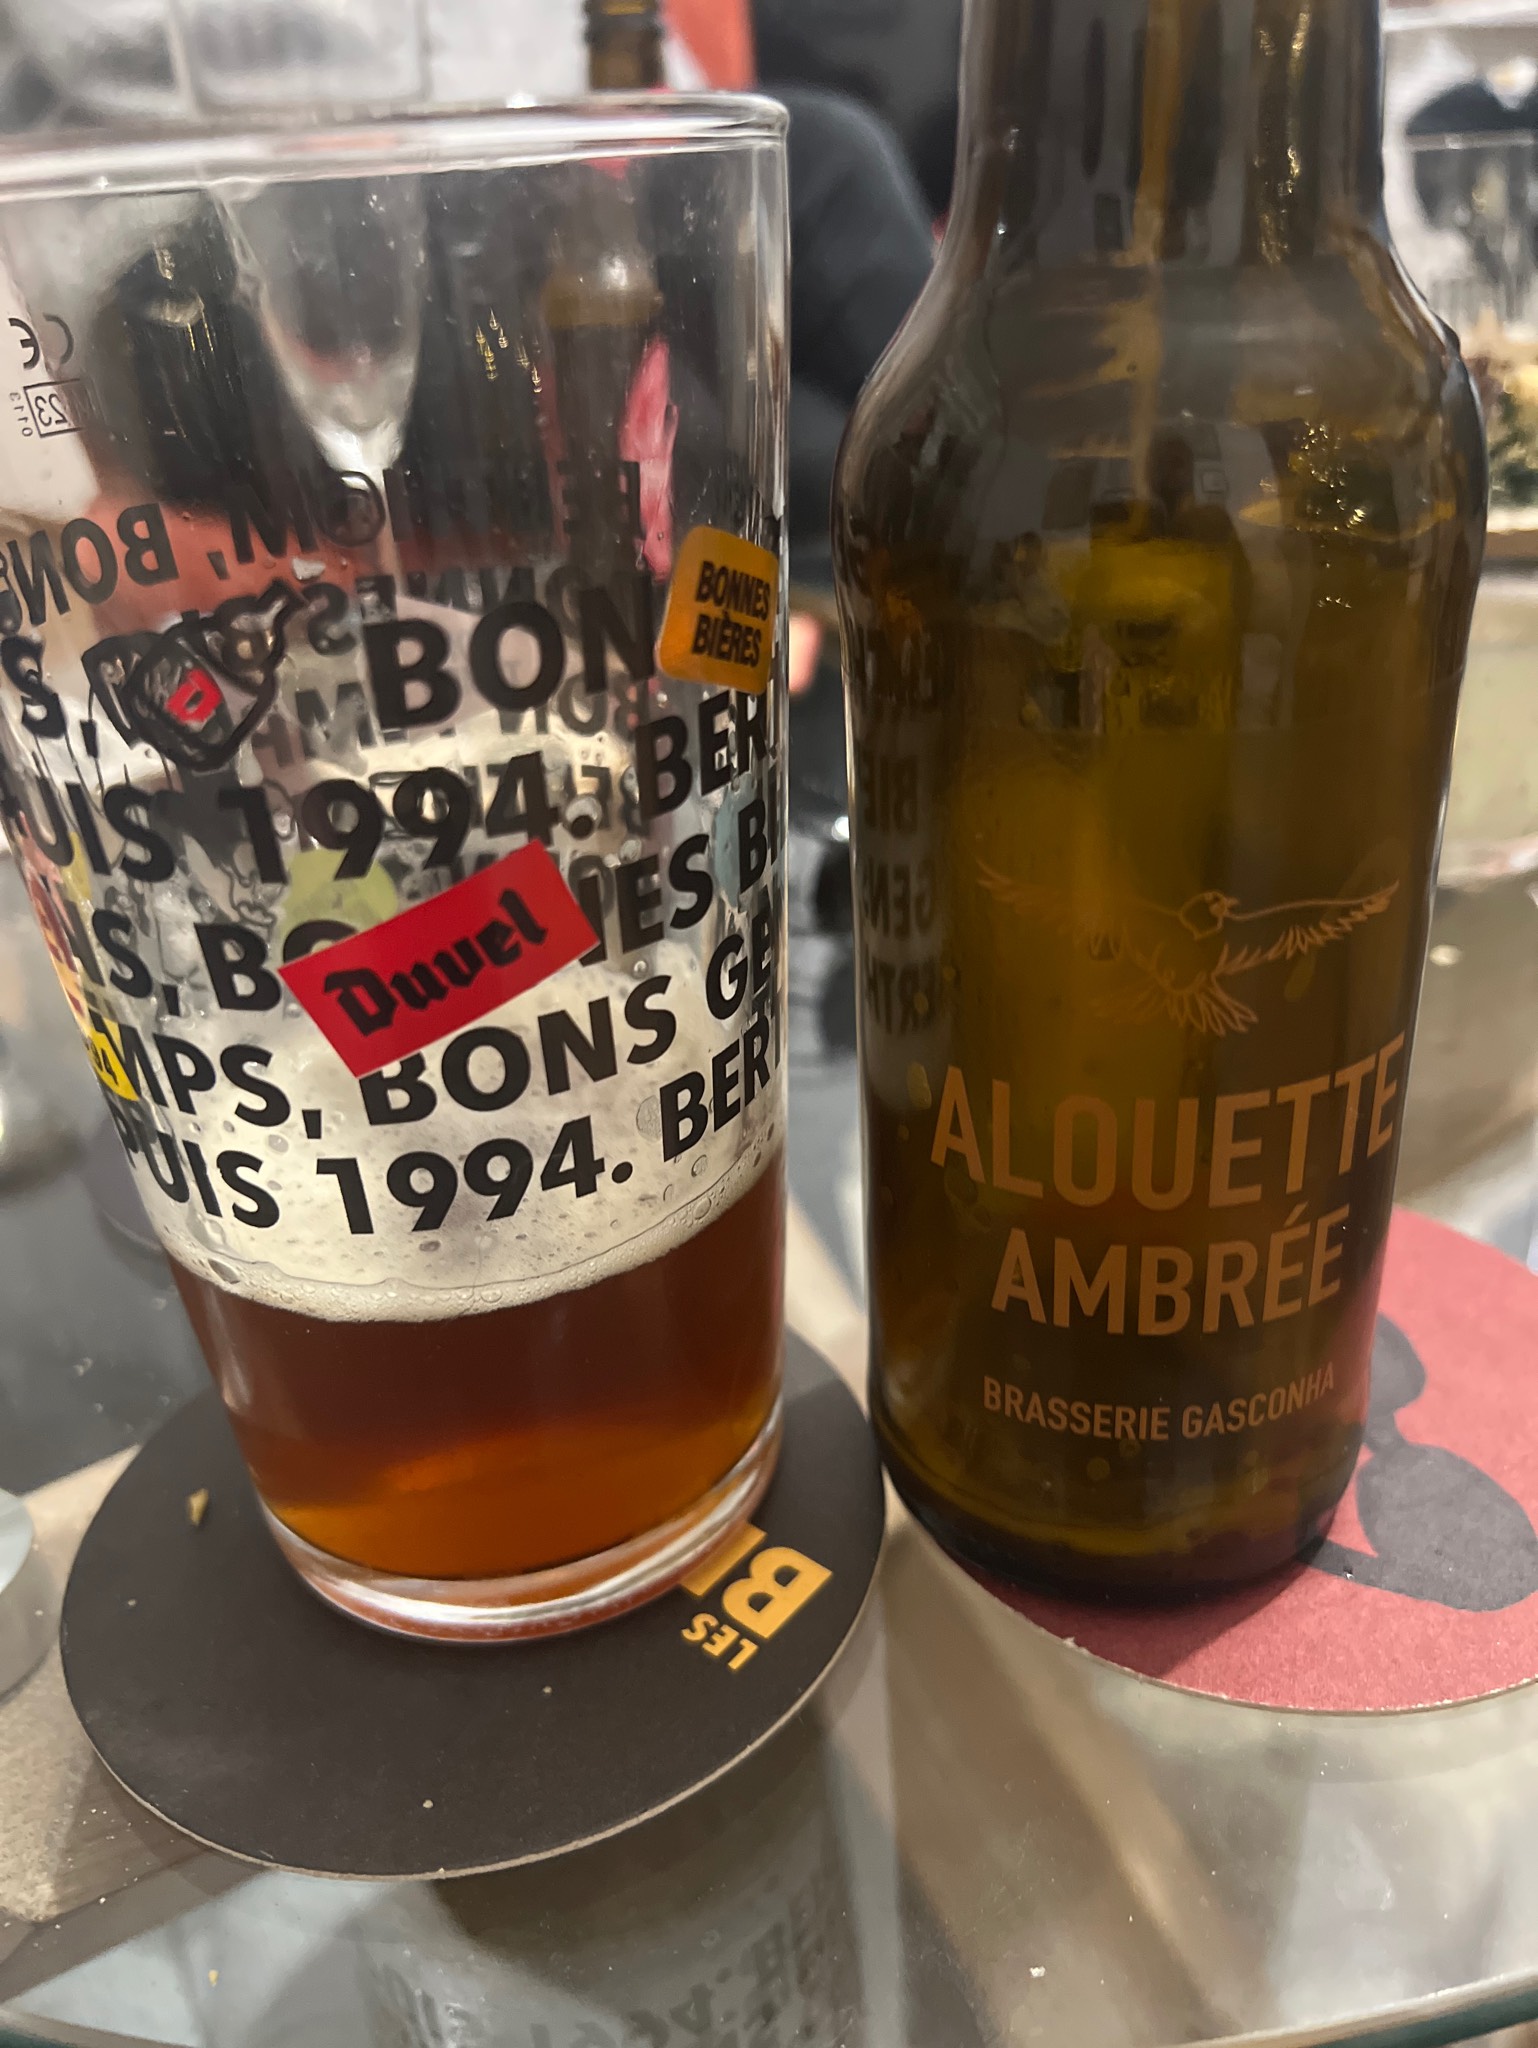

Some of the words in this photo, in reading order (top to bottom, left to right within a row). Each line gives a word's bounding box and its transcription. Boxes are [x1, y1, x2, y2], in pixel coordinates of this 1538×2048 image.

[364, 571, 655, 731] BON
[691, 608, 762, 668] BIÈRES
[695, 560, 771, 622] BONNES
[6, 766, 175, 884] UIS
[217, 750, 598, 886] 1994.
[633, 686, 768, 821] BER
[323, 887, 549, 1038] Duvel
[87, 1007, 323, 1140] MPS,
[358, 974, 678, 1126] BONS
[930, 1030, 1406, 1212] ALOUETTE
[314, 1114, 635, 1234] 1994.
[991, 1202, 1350, 1337] AMBRÉE
[983, 1375, 1171, 1442] BRASSERIE
[1181, 1361, 1335, 1439] GASCONHA
[681, 1612, 759, 1671] LES
